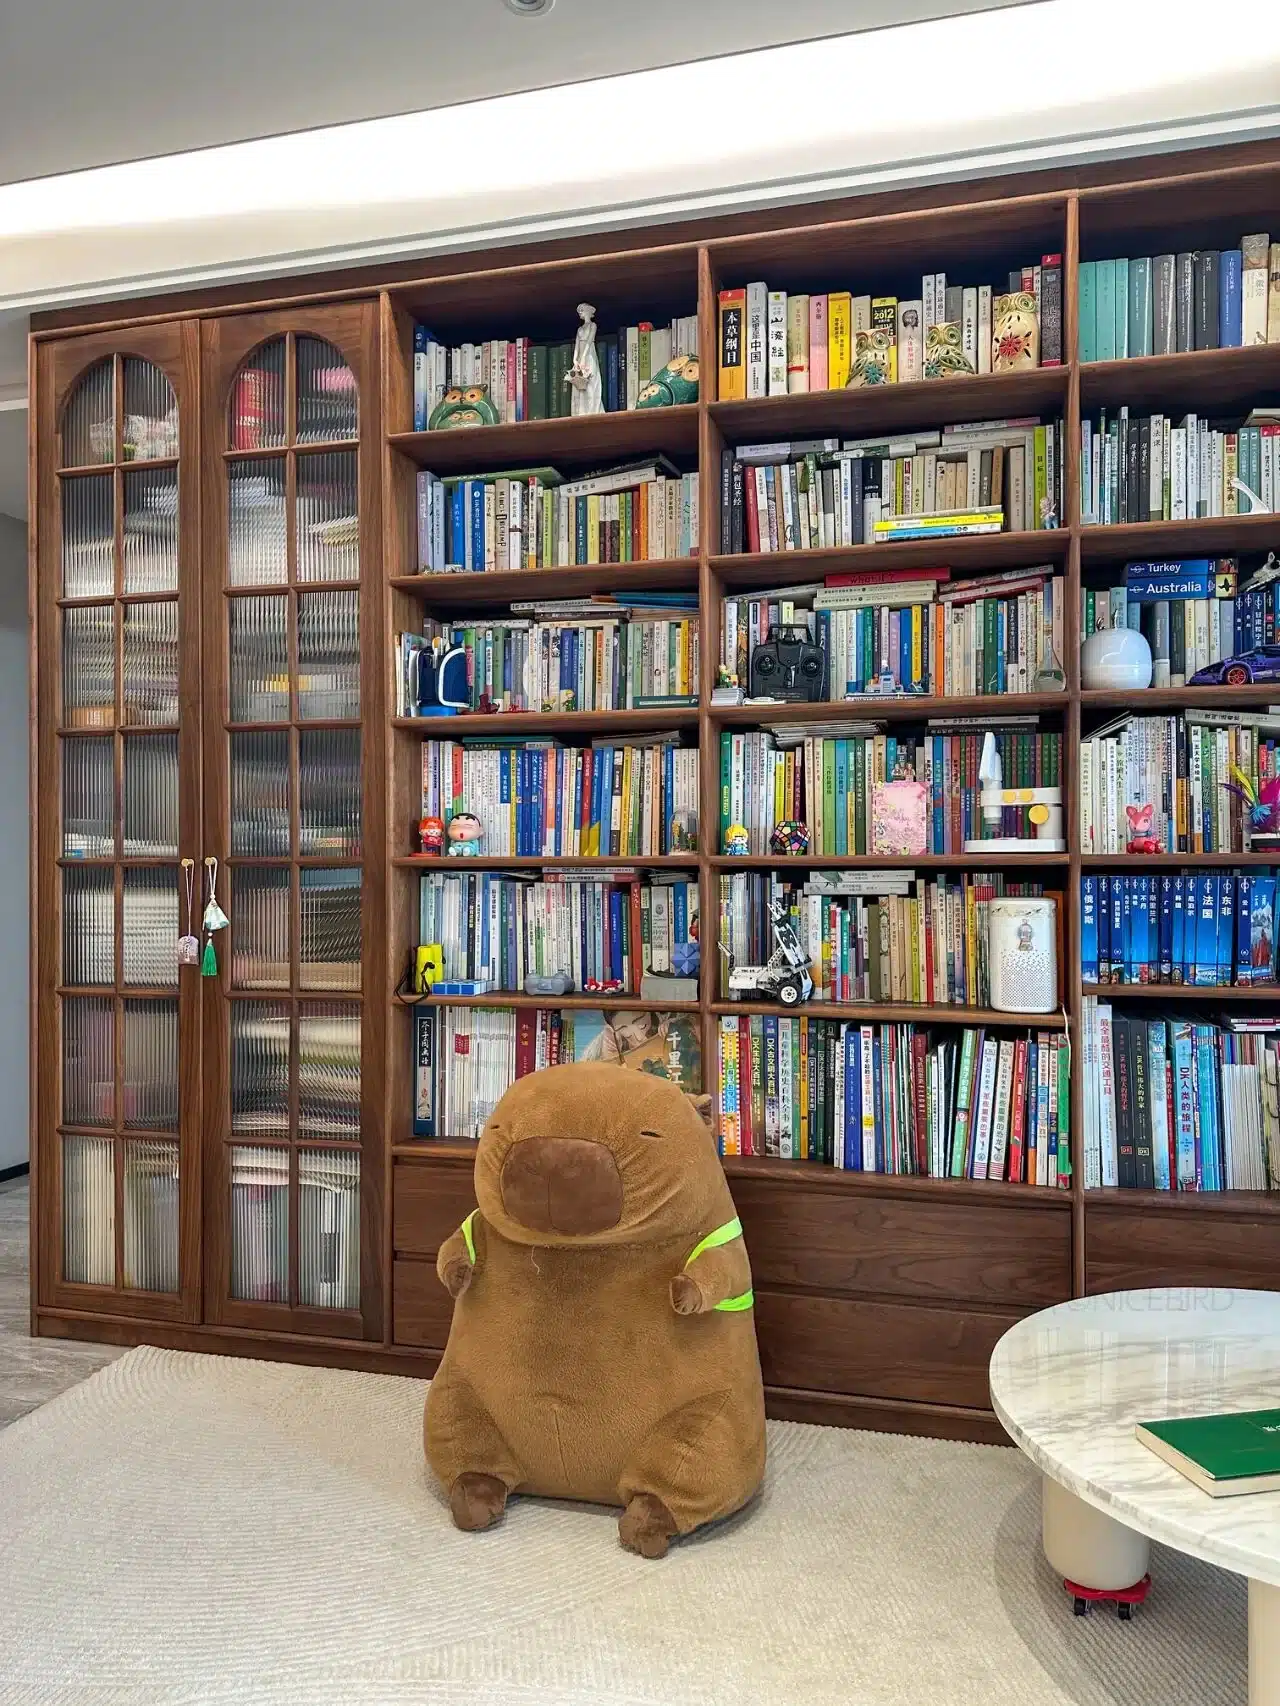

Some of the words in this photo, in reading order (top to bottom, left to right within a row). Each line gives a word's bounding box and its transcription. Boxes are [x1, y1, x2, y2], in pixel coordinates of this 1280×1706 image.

[874, 309, 895, 320] 2012
[725, 311, 738, 364] 本草纲目
[1147, 563, 1181, 574] Turkey
[1146, 581, 1202, 594] Australia
[1085, 895, 1094, 924] 俄罗斯
[1149, 895, 1157, 924] 斯里兰卡
[1202, 895, 1213, 919] 法国
[1221, 896, 1232, 916] 东非
[667, 1031, 685, 1085] 千里江
[1100, 1019, 1113, 1096] 最全最酷的交通工具
[1180, 1067, 1191, 1134] DK人类的旅程
